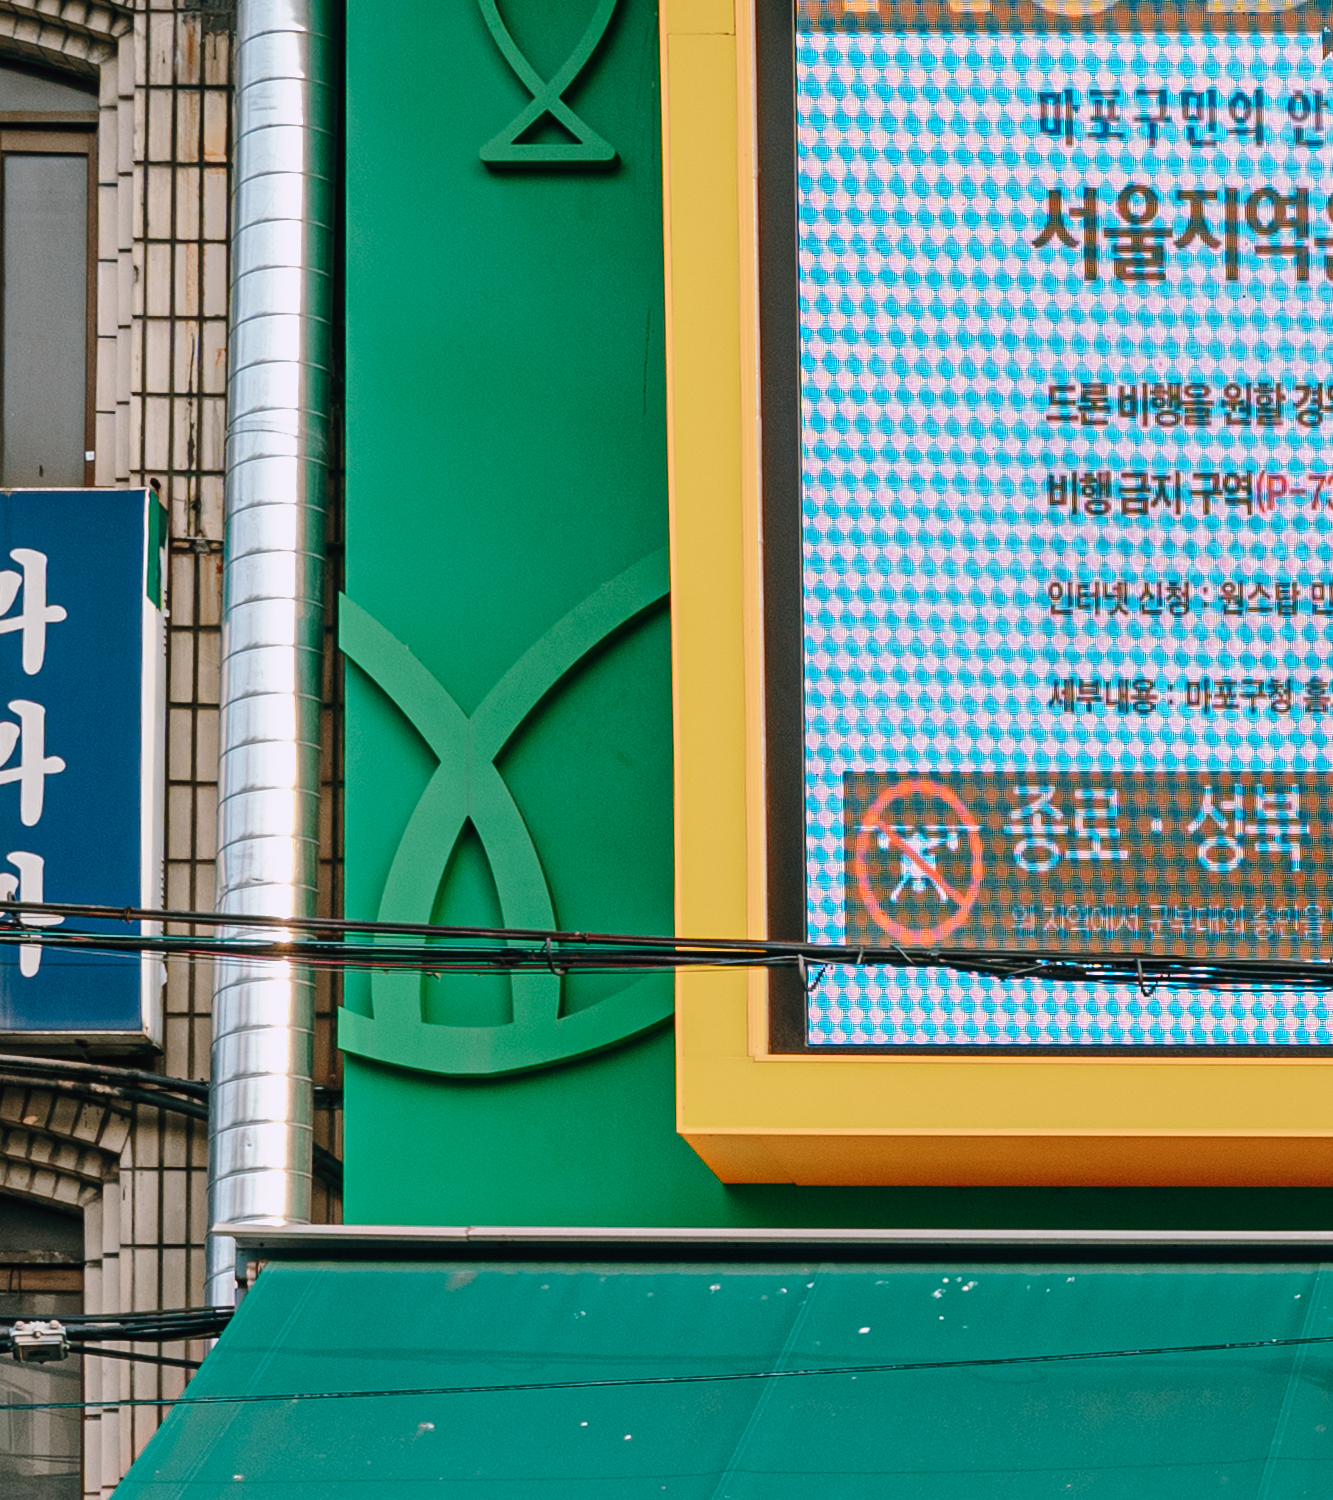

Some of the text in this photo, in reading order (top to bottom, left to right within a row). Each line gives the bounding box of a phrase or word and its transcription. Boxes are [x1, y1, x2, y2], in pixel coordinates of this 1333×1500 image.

[1037, 88, 1266, 148] 마포구민의
[1046, 383, 1111, 427] 드론
[1003, 784, 1129, 873] 종로
[1187, 784, 1310, 873] 성북
